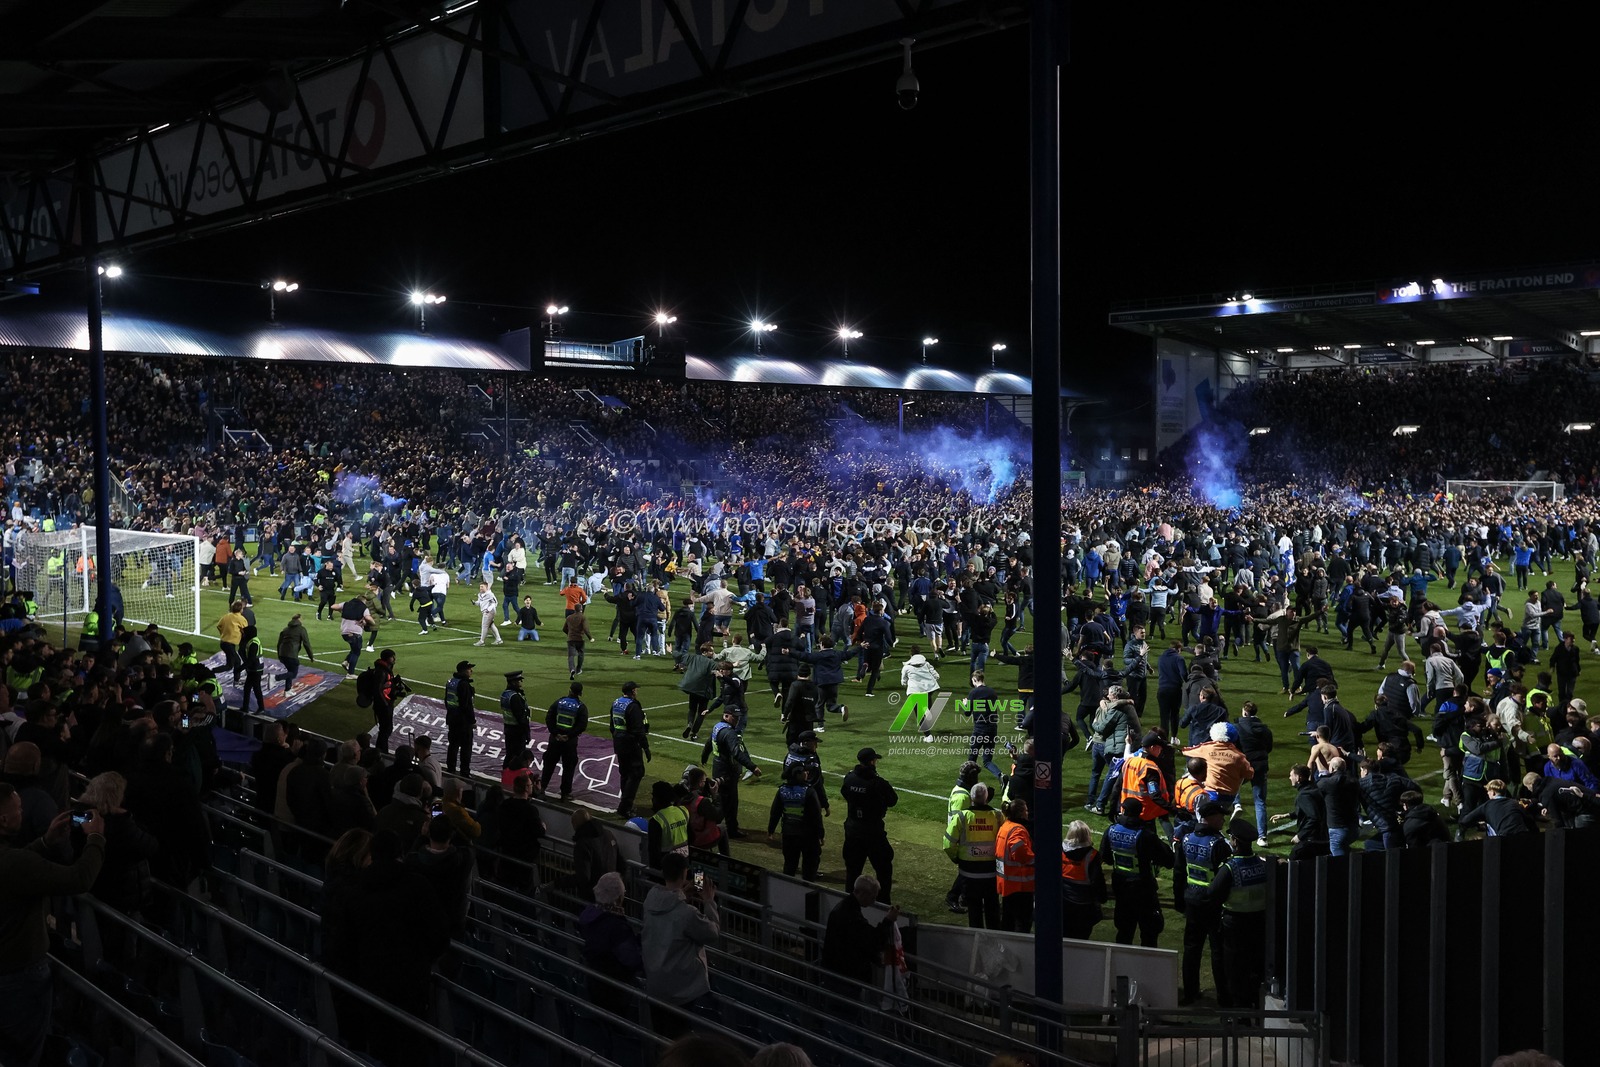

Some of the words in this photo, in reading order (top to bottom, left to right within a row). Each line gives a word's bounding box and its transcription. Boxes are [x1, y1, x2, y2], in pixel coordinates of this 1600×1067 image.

[1451, 281, 1477, 293] THE
[1479, 276, 1542, 291] FRATTON
[1545, 273, 1575, 285] END
[1283, 301, 1303, 309] Proud
[850, 785, 867, 794] POLICE
[1112, 832, 1134, 843] POLICE
[1186, 844, 1208, 857] POLICE
